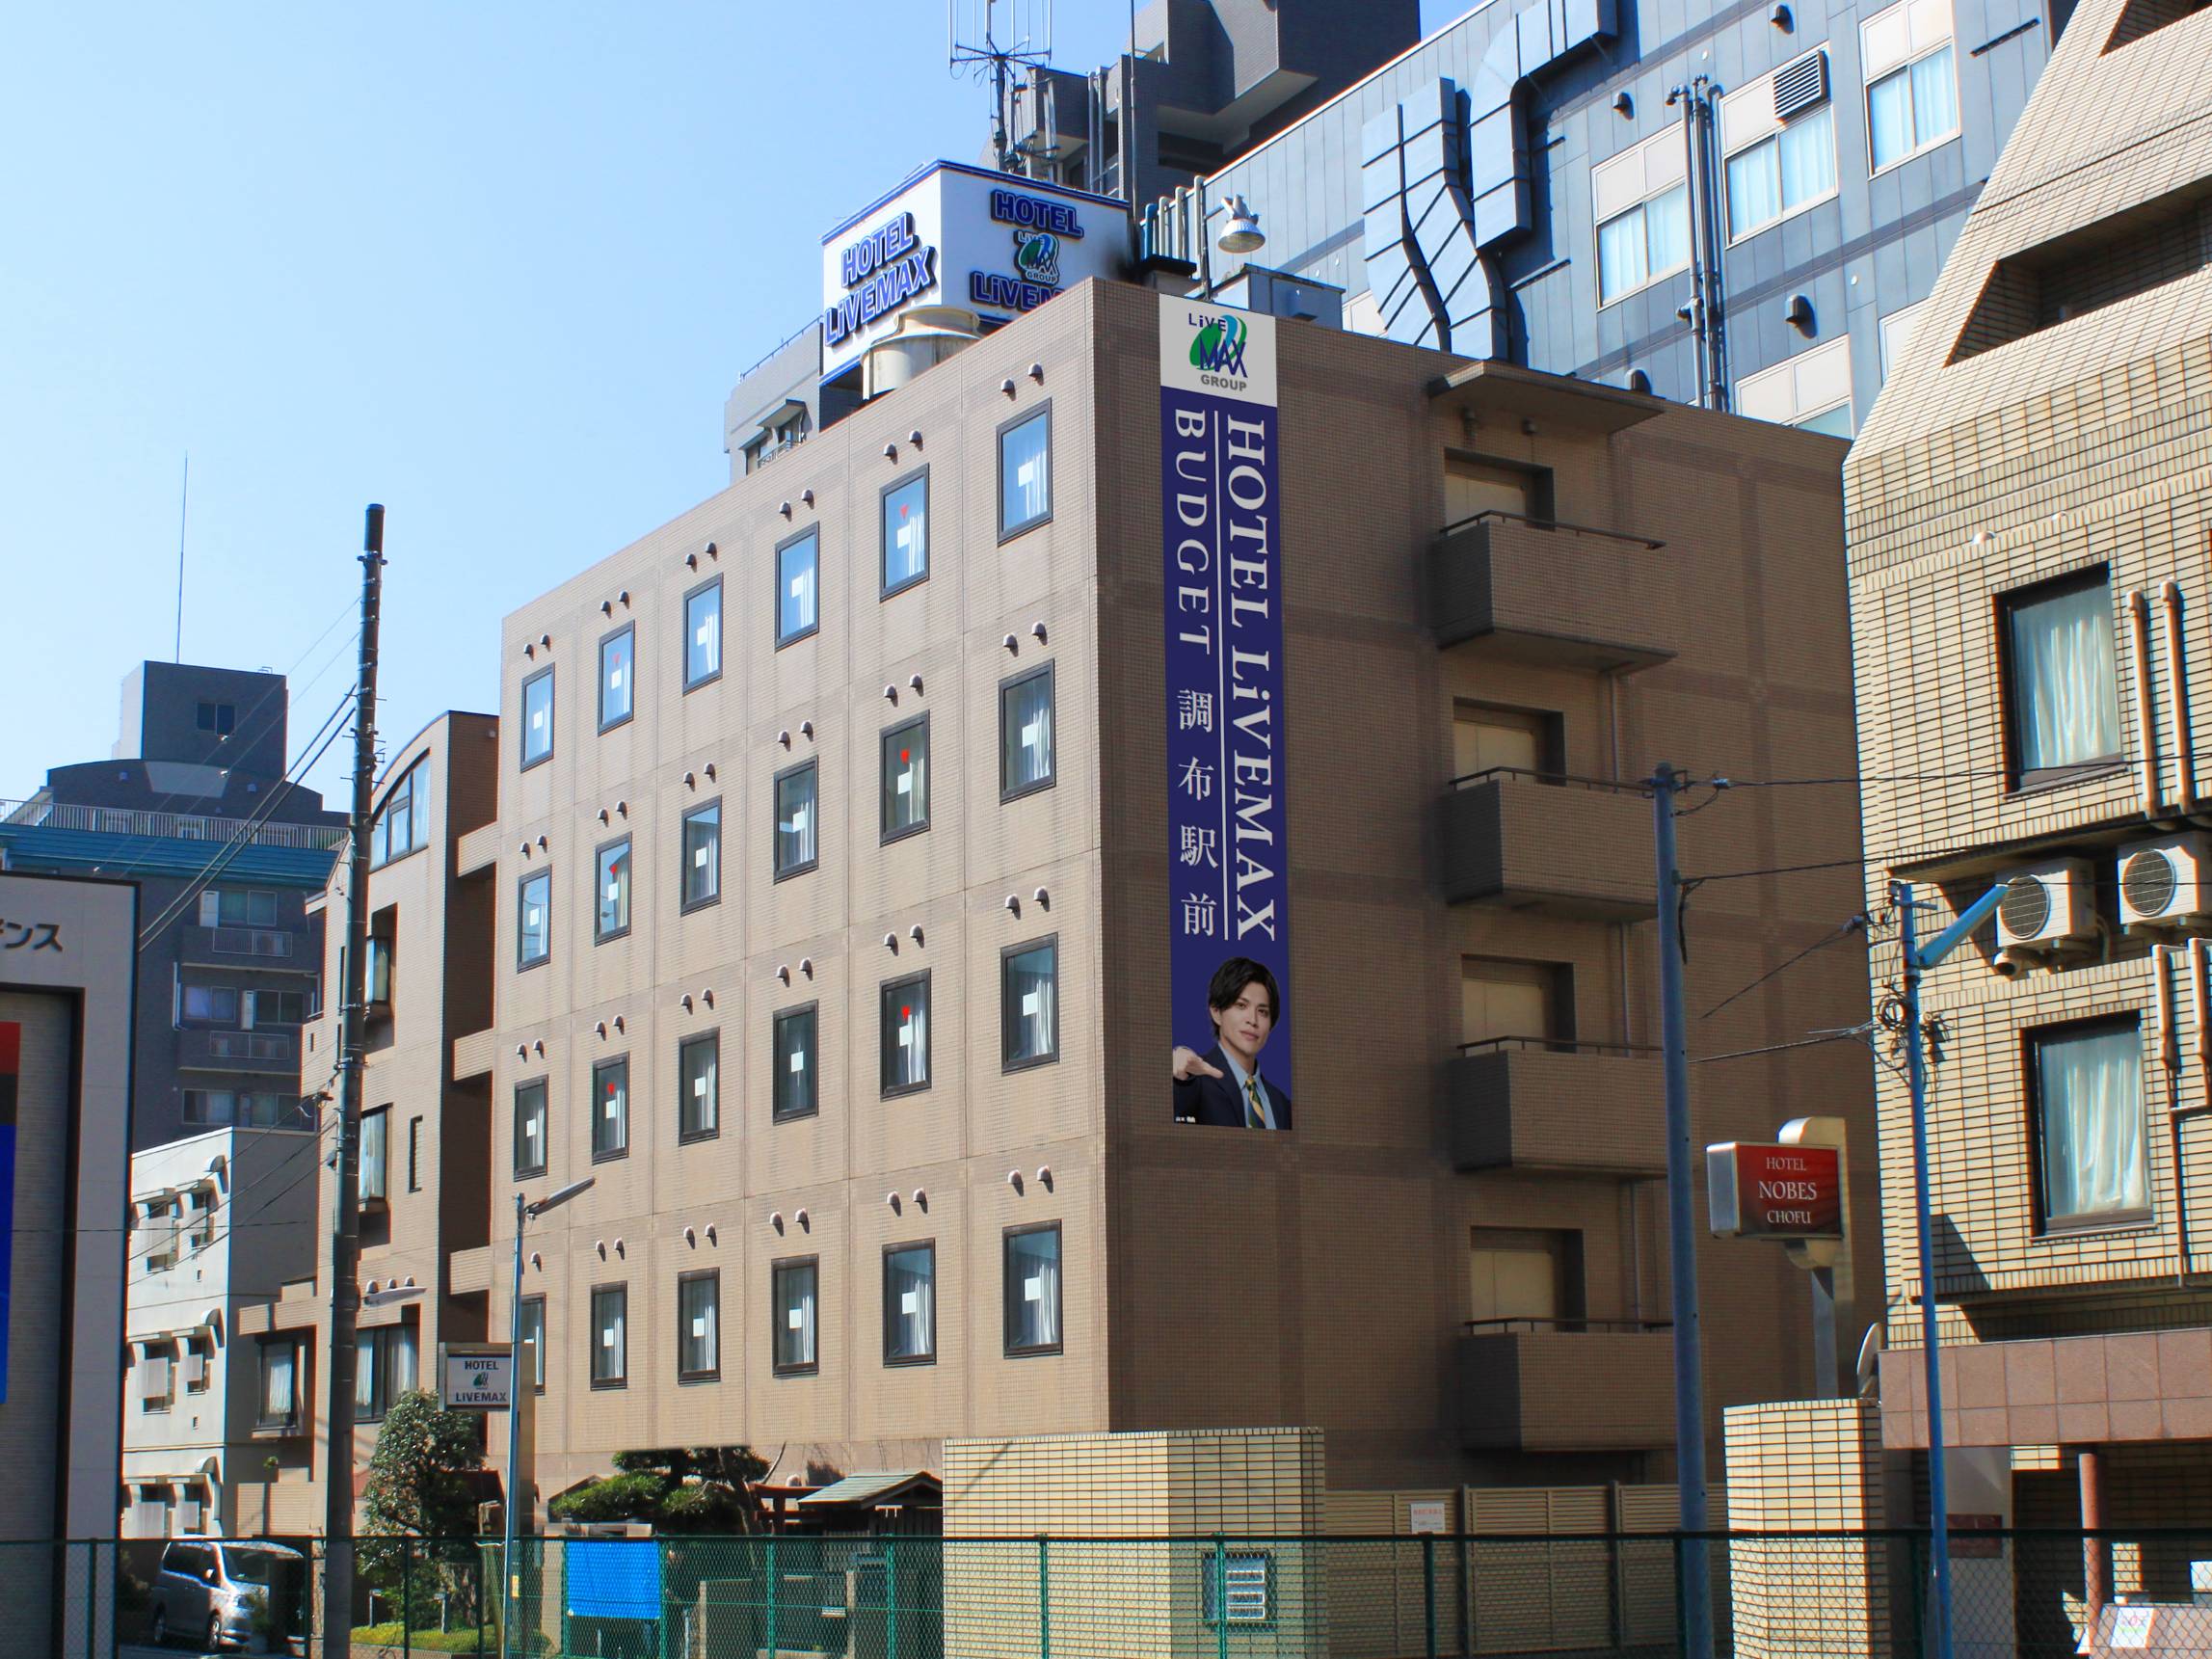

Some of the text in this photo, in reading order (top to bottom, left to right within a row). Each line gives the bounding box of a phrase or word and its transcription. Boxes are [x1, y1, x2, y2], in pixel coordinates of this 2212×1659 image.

[992, 190, 1084, 238] HOTEL
[841, 212, 915, 288] HOTEL
[1026, 270, 1058, 283] GROUP
[825, 246, 936, 347] LiVEMAX
[1188, 312, 1227, 332] LiVE
[1199, 335, 1248, 378] MAX
[1201, 374, 1247, 391] GROUP
[1175, 409, 1210, 655] BUDGET
[1227, 415, 1275, 942] HOTEL LiVEMAX
[1177, 688, 1218, 937] 調布駅前
[0, 918, 64, 951] ンス
[1766, 1157, 1807, 1171] HOTEL
[1758, 1181, 1818, 1200] NOBES
[1767, 1210, 1811, 1224] CHOFU
[465, 1360, 499, 1370] HOTEL
